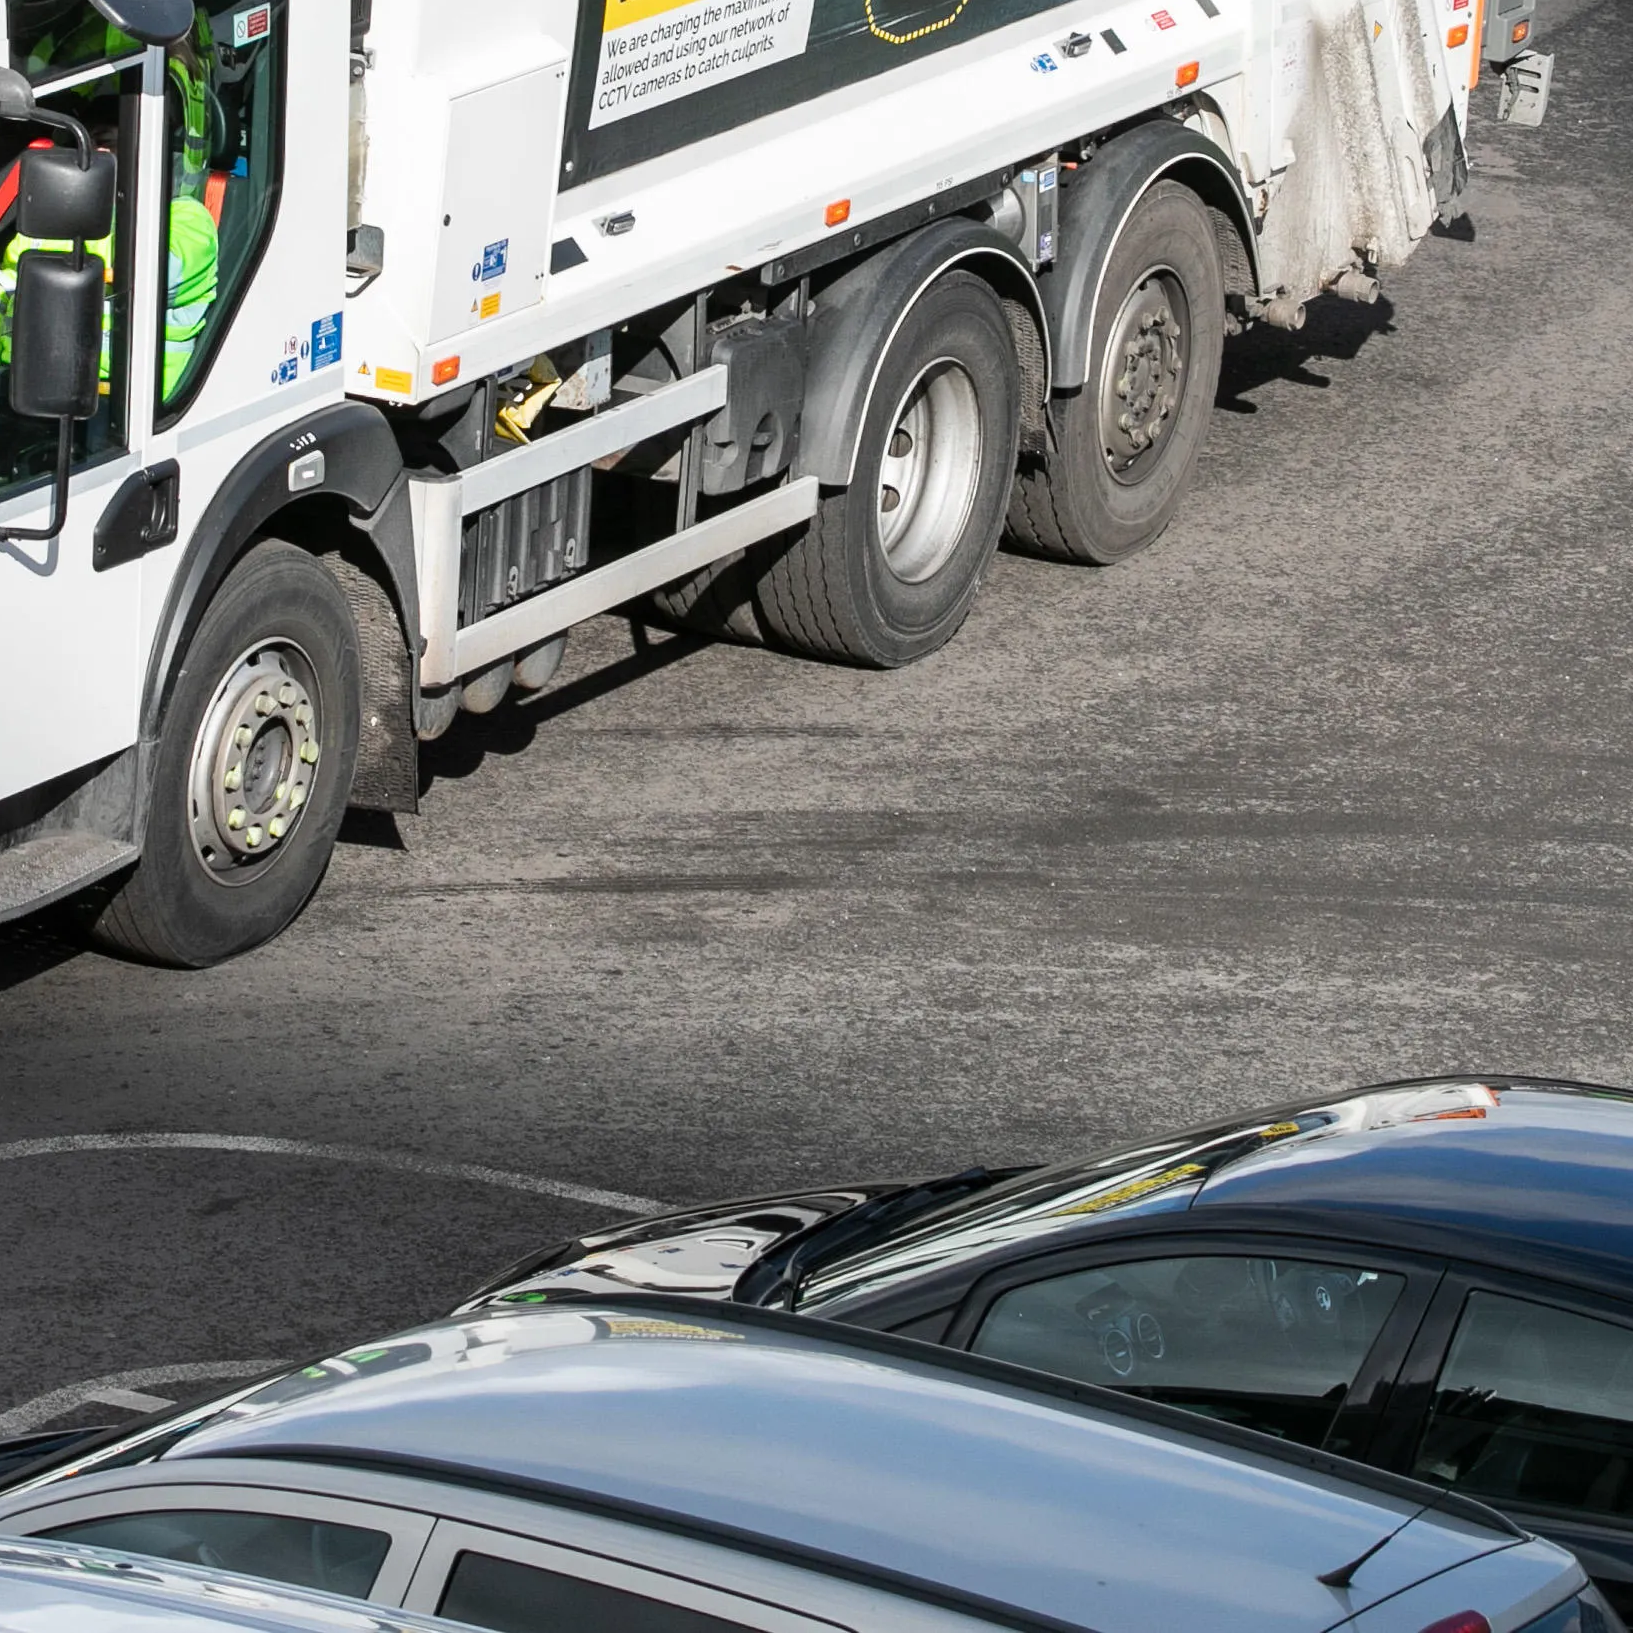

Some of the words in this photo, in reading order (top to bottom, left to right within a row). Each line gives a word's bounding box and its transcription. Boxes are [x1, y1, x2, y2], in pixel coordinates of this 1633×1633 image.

[602, 58, 648, 85] allowed
[651, 47, 673, 68] and
[676, 38, 706, 60] using
[708, 30, 727, 48] our
[729, 11, 775, 42] network
[777, 3, 791, 23] of
[607, 40, 627, 59] We
[629, 34, 648, 52] are
[650, 15, 701, 44] charging
[703, 6, 722, 26] the
[598, 83, 632, 111] CCTV
[632, 70, 681, 99] cameras
[684, 65, 696, 80] to
[698, 50, 729, 75] catch
[731, 35, 775, 64] culprits.
